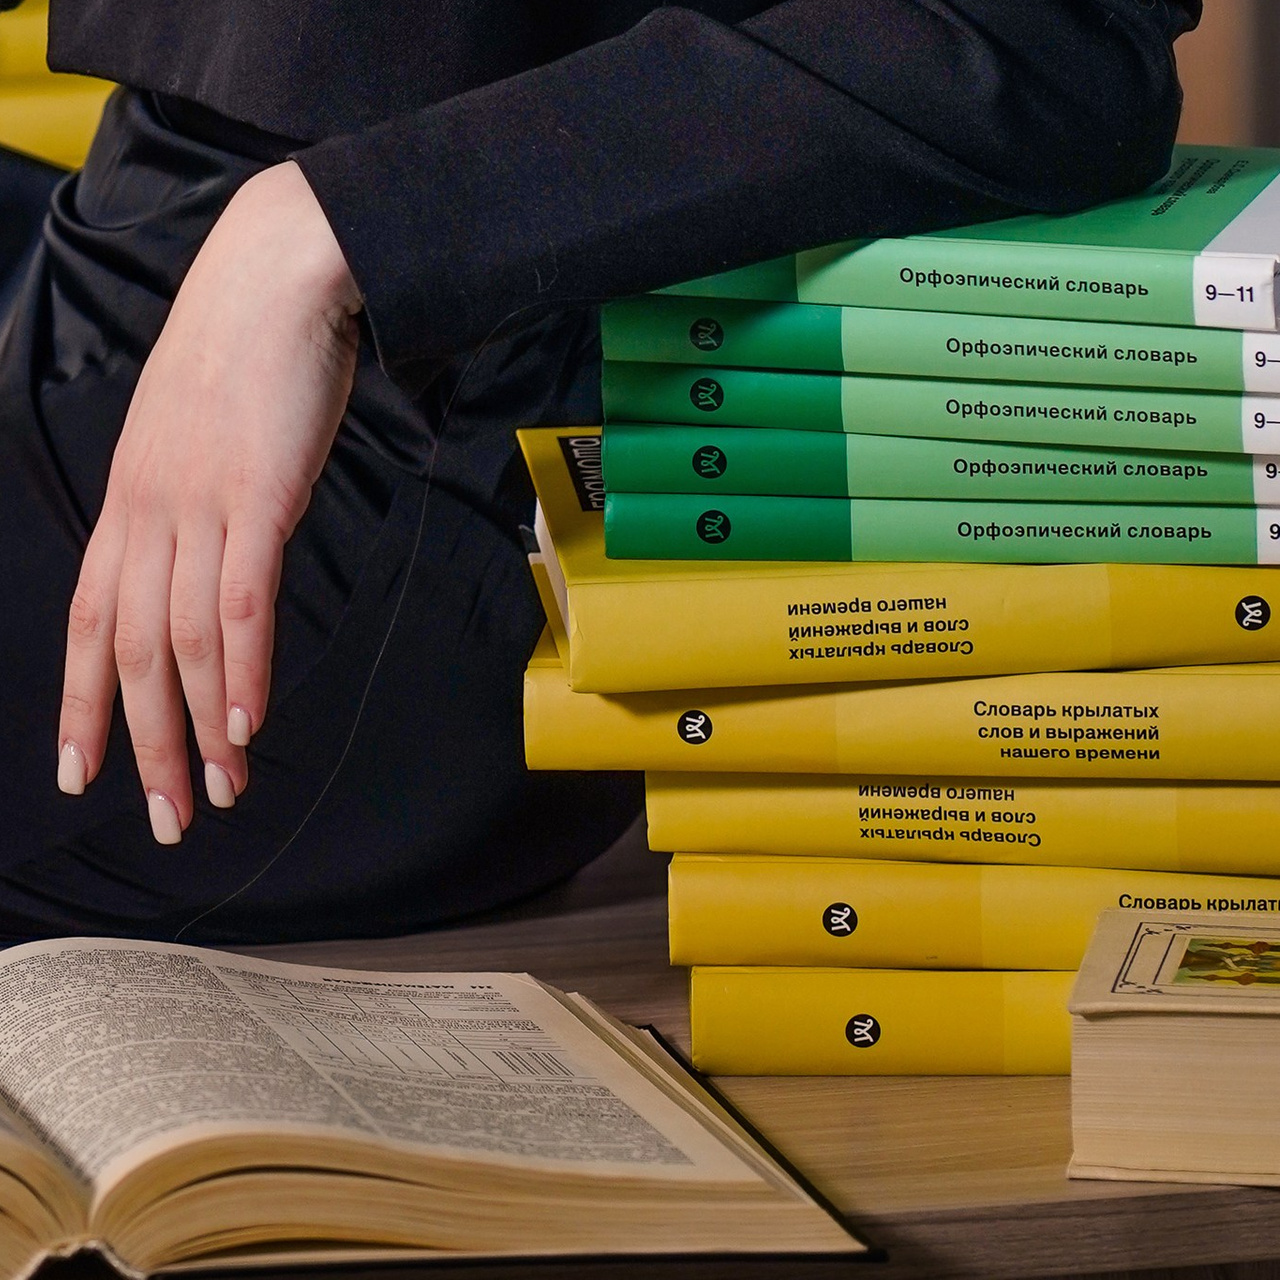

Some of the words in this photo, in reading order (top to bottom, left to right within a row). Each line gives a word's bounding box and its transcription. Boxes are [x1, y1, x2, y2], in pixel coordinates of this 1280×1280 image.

[899, 267, 1060, 291] Орфоэпический
[1065, 280, 1149, 299] словарь
[946, 337, 1108, 360] Орфоэпический
[1113, 348, 1198, 367] словарь
[945, 399, 1107, 421] Орфоэпический
[1113, 409, 1197, 428] словарь
[953, 458, 1117, 478] Орфоэпический
[1122, 461, 1209, 481] словарь
[957, 521, 1121, 541] Орфоэпический
[1127, 526, 1212, 543] словарь
[786, 598, 873, 618] времени
[876, 597, 947, 612] нашего
[788, 619, 902, 643] выражений
[907, 621, 918, 634] и
[923, 619, 969, 633] слов
[788, 643, 886, 660] крылатых
[890, 639, 974, 655] Словарь
[973, 700, 1057, 721] Словарь
[1062, 705, 1159, 721] крылатых
[978, 726, 1024, 739] слов
[1029, 727, 1040, 739] и
[1045, 723, 1159, 742] выражений
[1000, 747, 1071, 759] нашего
[1075, 748, 1160, 762] времени
[857, 783, 942, 800] времени
[946, 787, 1015, 802] нашего
[858, 805, 970, 824] выражений
[975, 810, 986, 822] и
[991, 811, 1036, 824] слов
[859, 826, 955, 841] крылатых
[959, 828, 1042, 847] Словарь
[1118, 893, 1202, 911] Словарь
